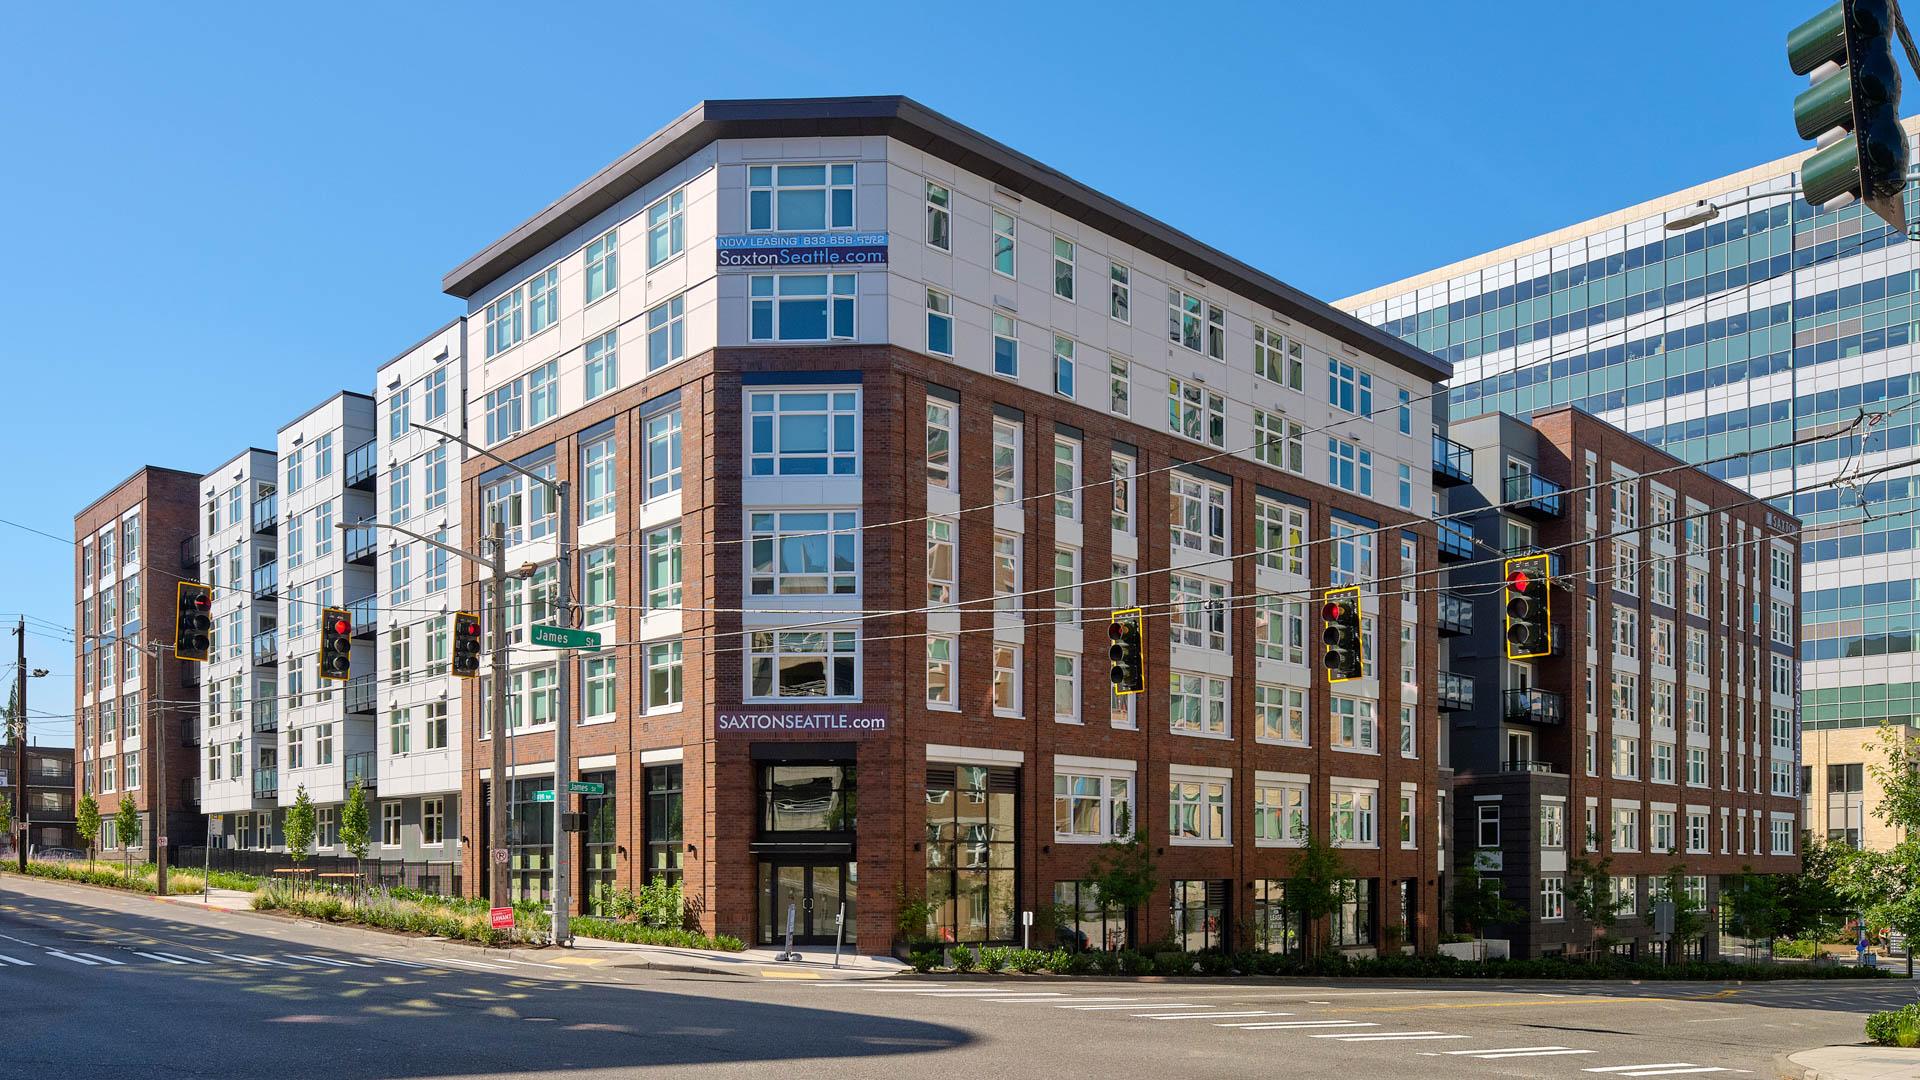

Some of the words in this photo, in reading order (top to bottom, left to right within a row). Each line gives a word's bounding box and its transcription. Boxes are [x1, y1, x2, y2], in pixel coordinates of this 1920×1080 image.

[719, 238, 748, 247] NOW
[750, 237, 798, 247] LEASING
[719, 248, 882, 265] SaxtonSeattle.com
[535, 629, 569, 644] James
[585, 636, 595, 647] St
[719, 714, 885, 730] SAXTONSEATTLE.com
[570, 783, 588, 792] James
